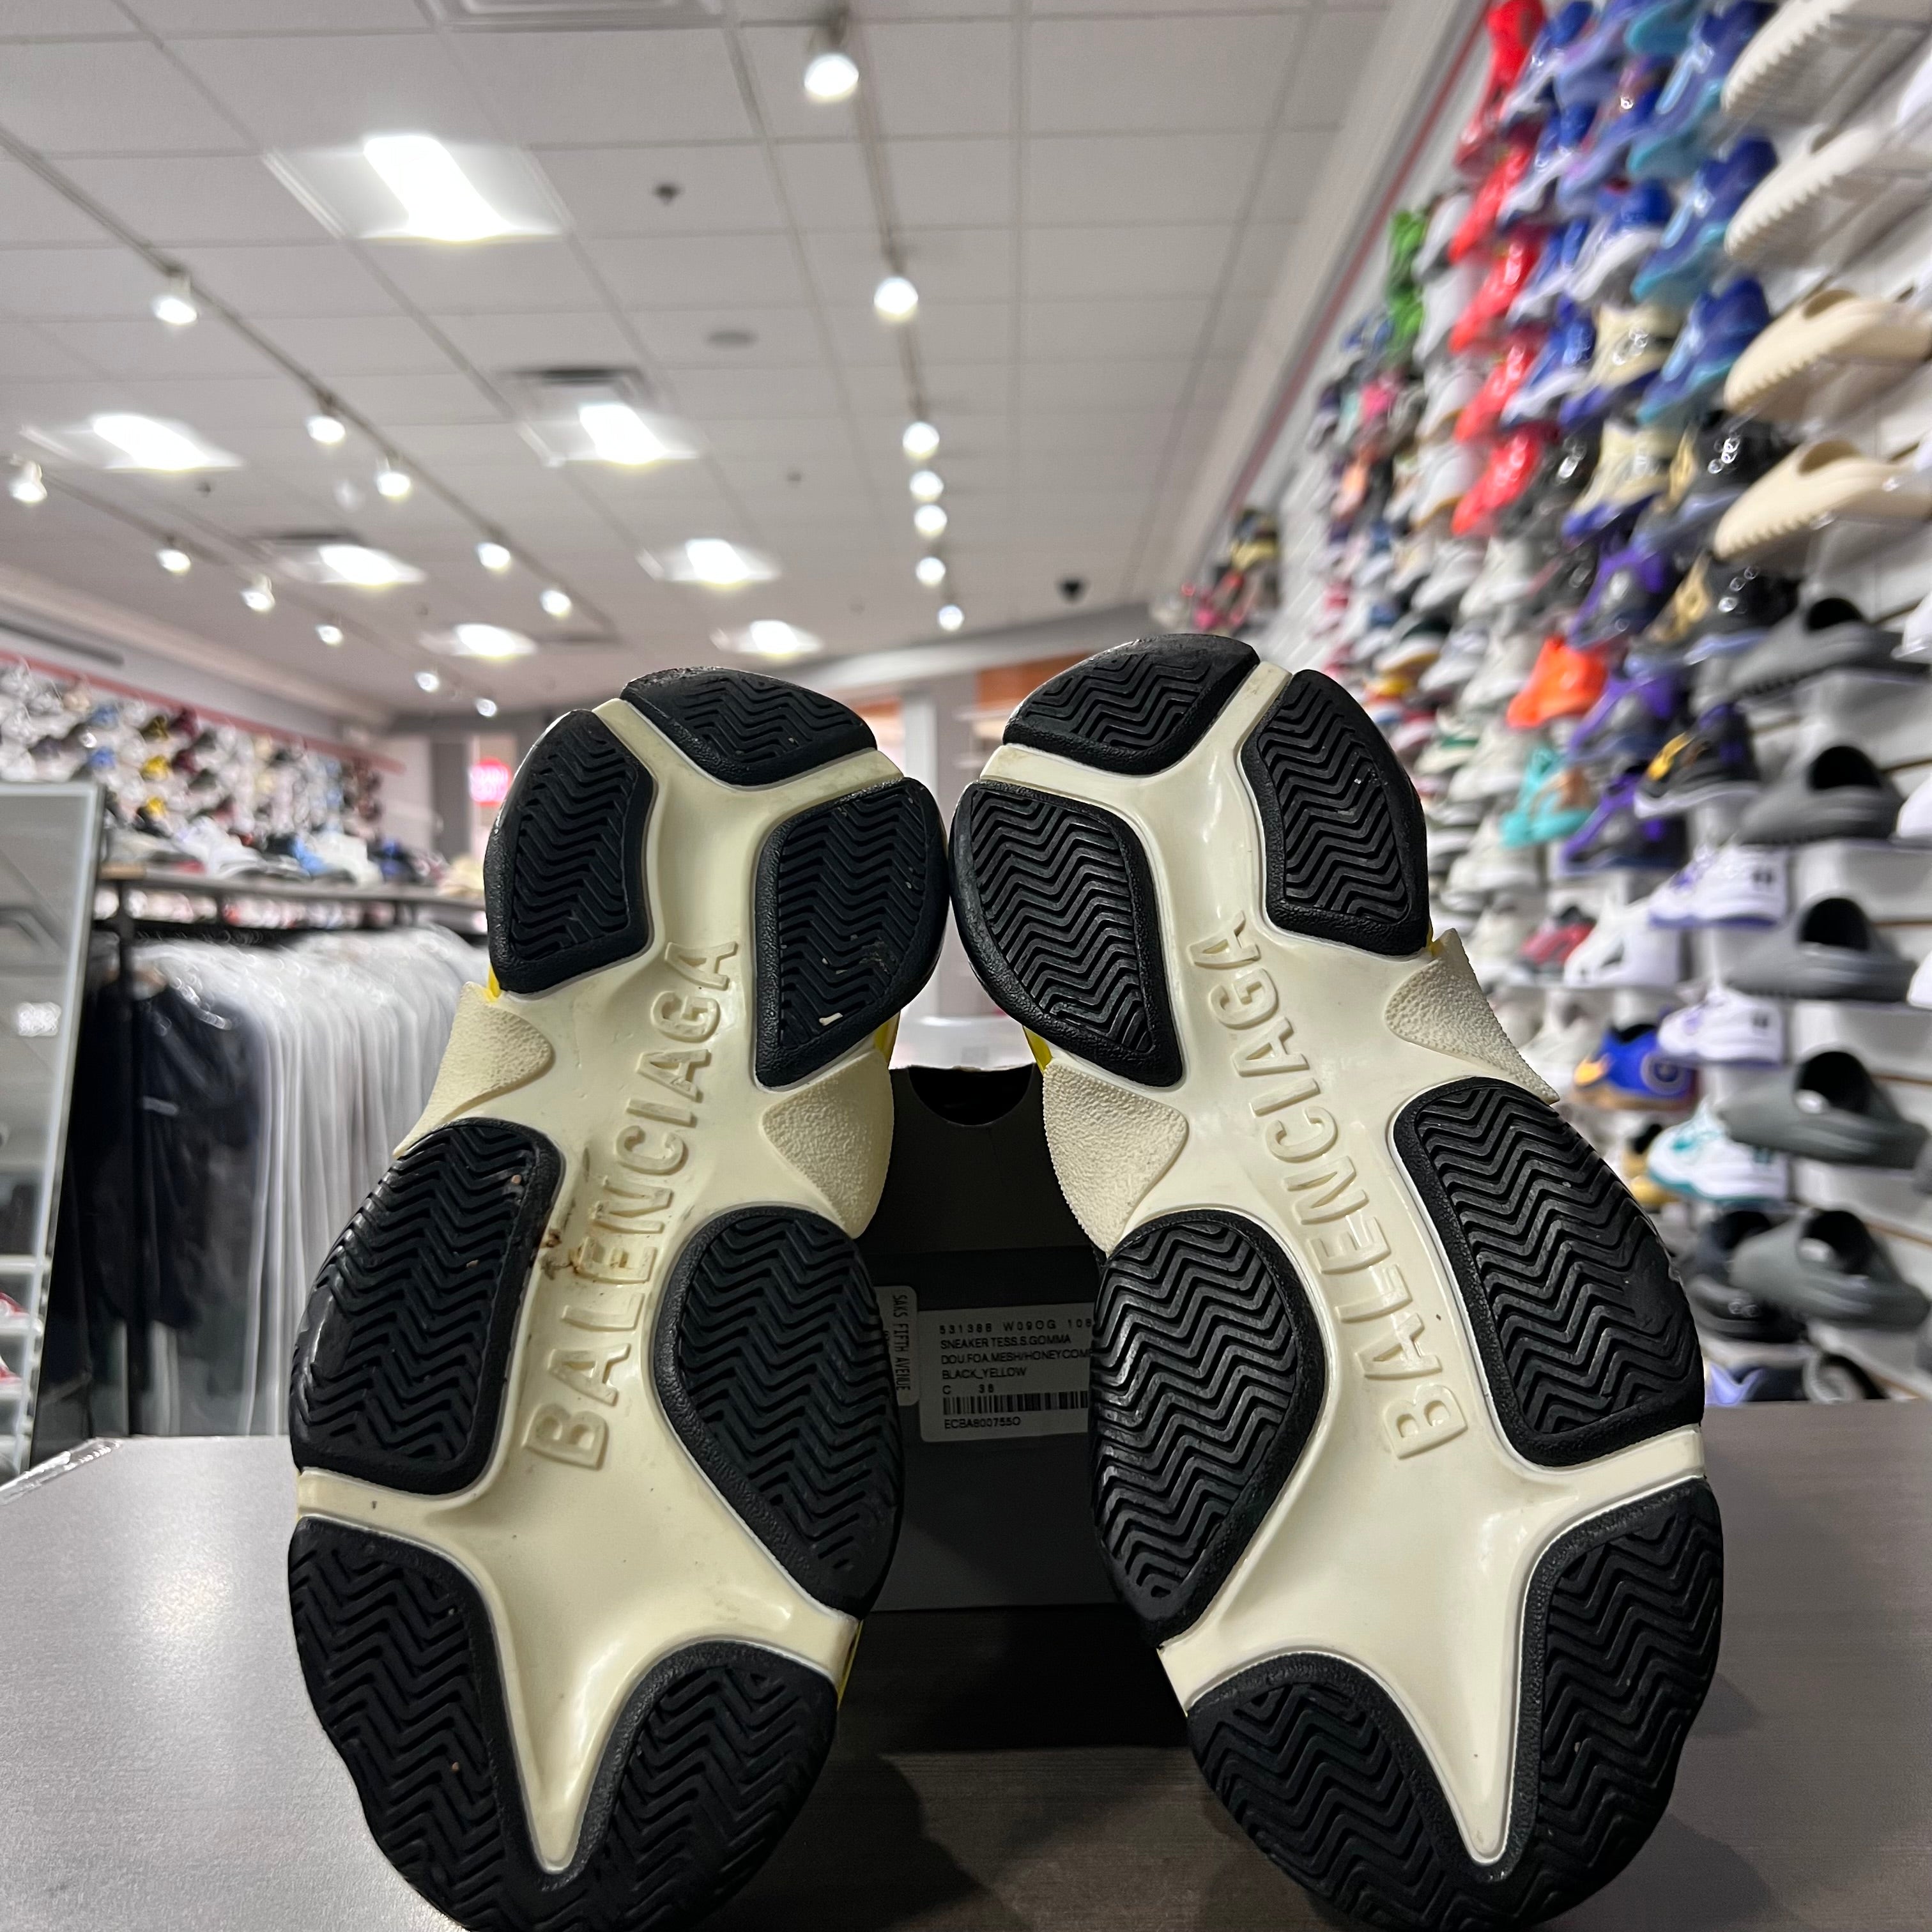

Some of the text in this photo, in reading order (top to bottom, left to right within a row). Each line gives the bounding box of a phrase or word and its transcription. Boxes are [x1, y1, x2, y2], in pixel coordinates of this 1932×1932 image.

[521, 939, 738, 1471] BALENCIAGA
[1186, 910, 1468, 1460] BALENCIAGA
[893, 1294, 911, 1392] SAKS FIFTH AVENUE
[940, 1337, 989, 1349] SNEAKER
[942, 1367, 1027, 1379] BLACK_YELLOW
[942, 1384, 951, 1395] C
